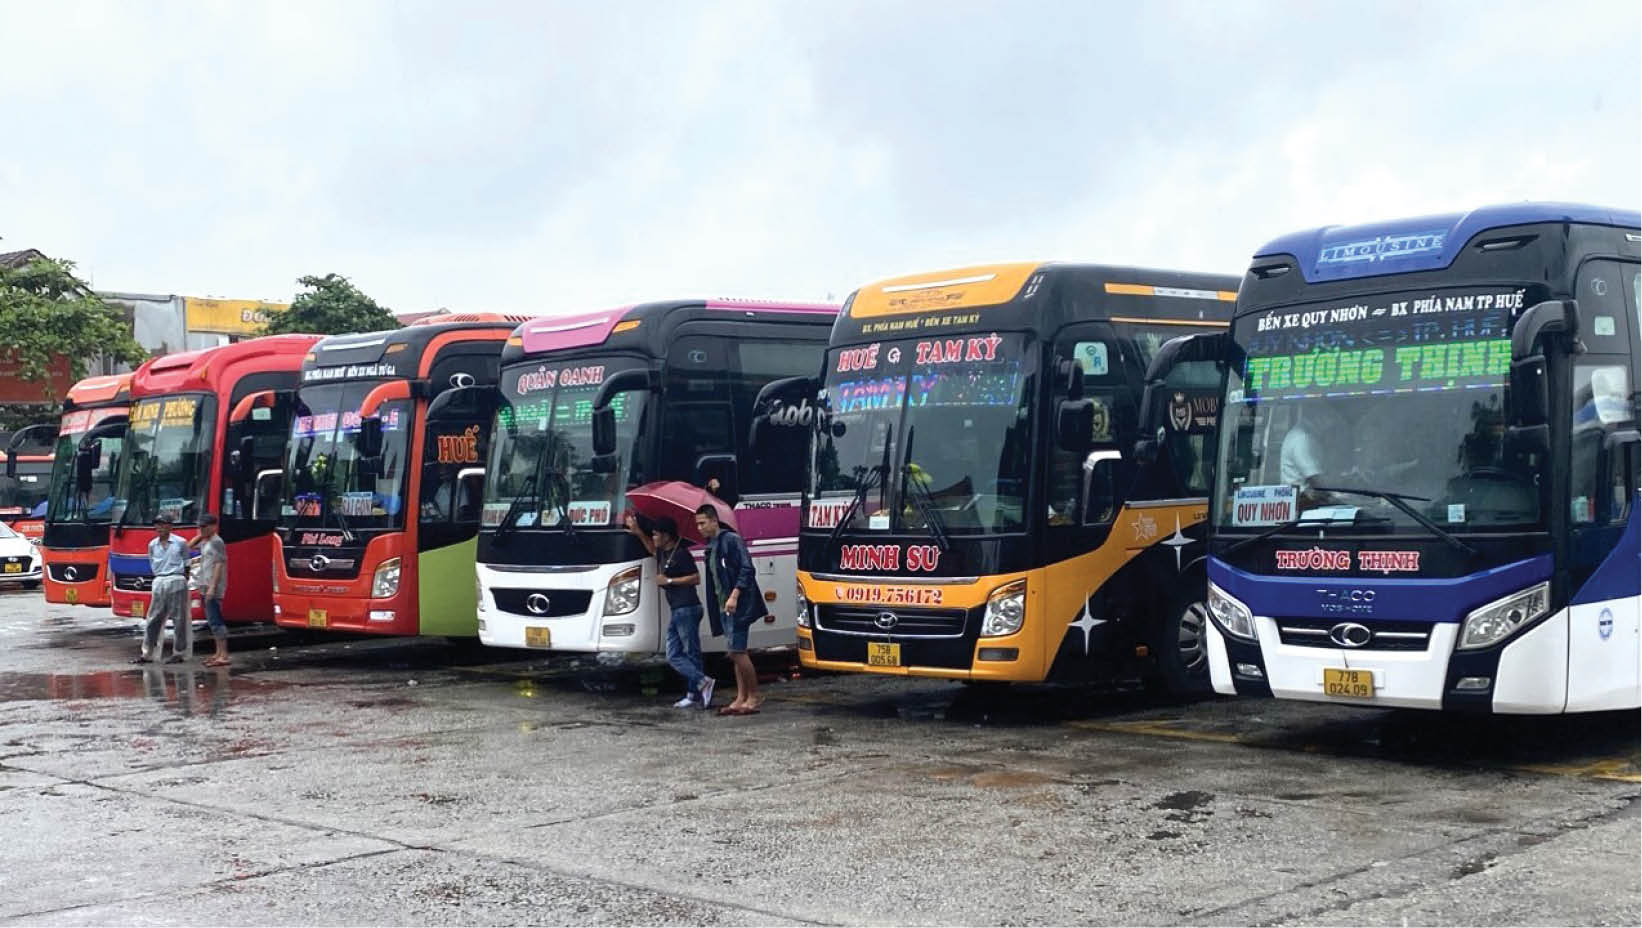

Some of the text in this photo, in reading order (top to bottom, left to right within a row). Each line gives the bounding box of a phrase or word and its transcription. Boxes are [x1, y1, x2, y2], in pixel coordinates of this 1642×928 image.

[1320, 236, 1443, 261] LIMOUSINE
[1257, 310, 1282, 332] BẾN
[1283, 313, 1300, 328] XE
[1301, 310, 1328, 329] QUY
[1330, 305, 1369, 323] NHƠN
[1391, 301, 1408, 317] BX
[1413, 295, 1443, 314] PHÍA
[1445, 295, 1475, 312] NAM
[1476, 295, 1494, 310] TP
[837, 343, 881, 372] HUẾ
[916, 340, 963, 364] TAM
[965, 332, 1002, 361] KỲ
[437, 424, 480, 464] HUẾ
[811, 503, 831, 527] TAM
[1237, 500, 1291, 523] QUY NHƠN
[840, 544, 901, 570] MINH
[1276, 546, 1420, 575] TRƯỜNG THỊNH
[847, 586, 943, 605] 0919.756172
[1337, 671, 1359, 683] 77B
